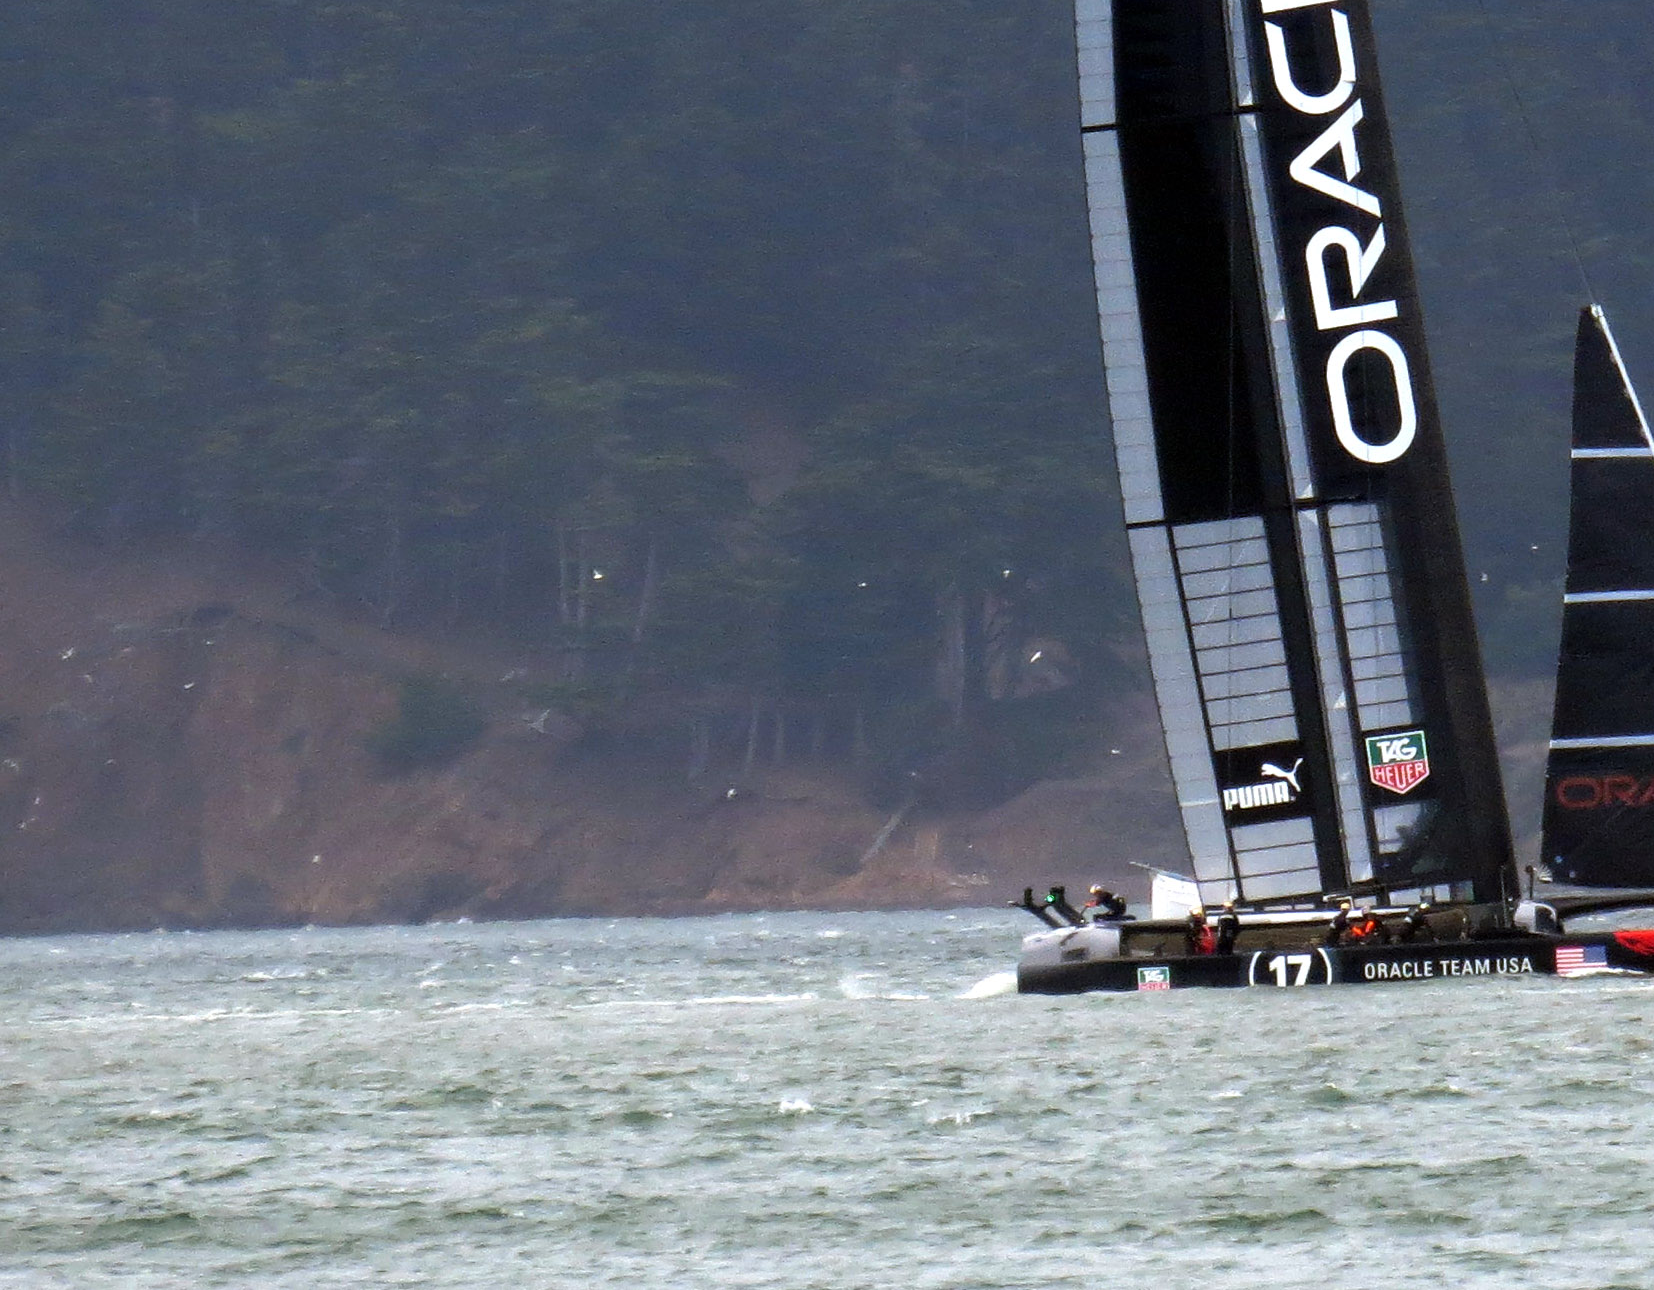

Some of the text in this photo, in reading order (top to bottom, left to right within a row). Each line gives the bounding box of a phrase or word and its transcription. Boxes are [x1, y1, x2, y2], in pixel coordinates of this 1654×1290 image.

[1376, 737, 1418, 763] TAG
[1375, 762, 1426, 789] HEUER
[1223, 781, 1290, 811] PUMA
[1364, 957, 1534, 980] ORACLE TEAM USA
